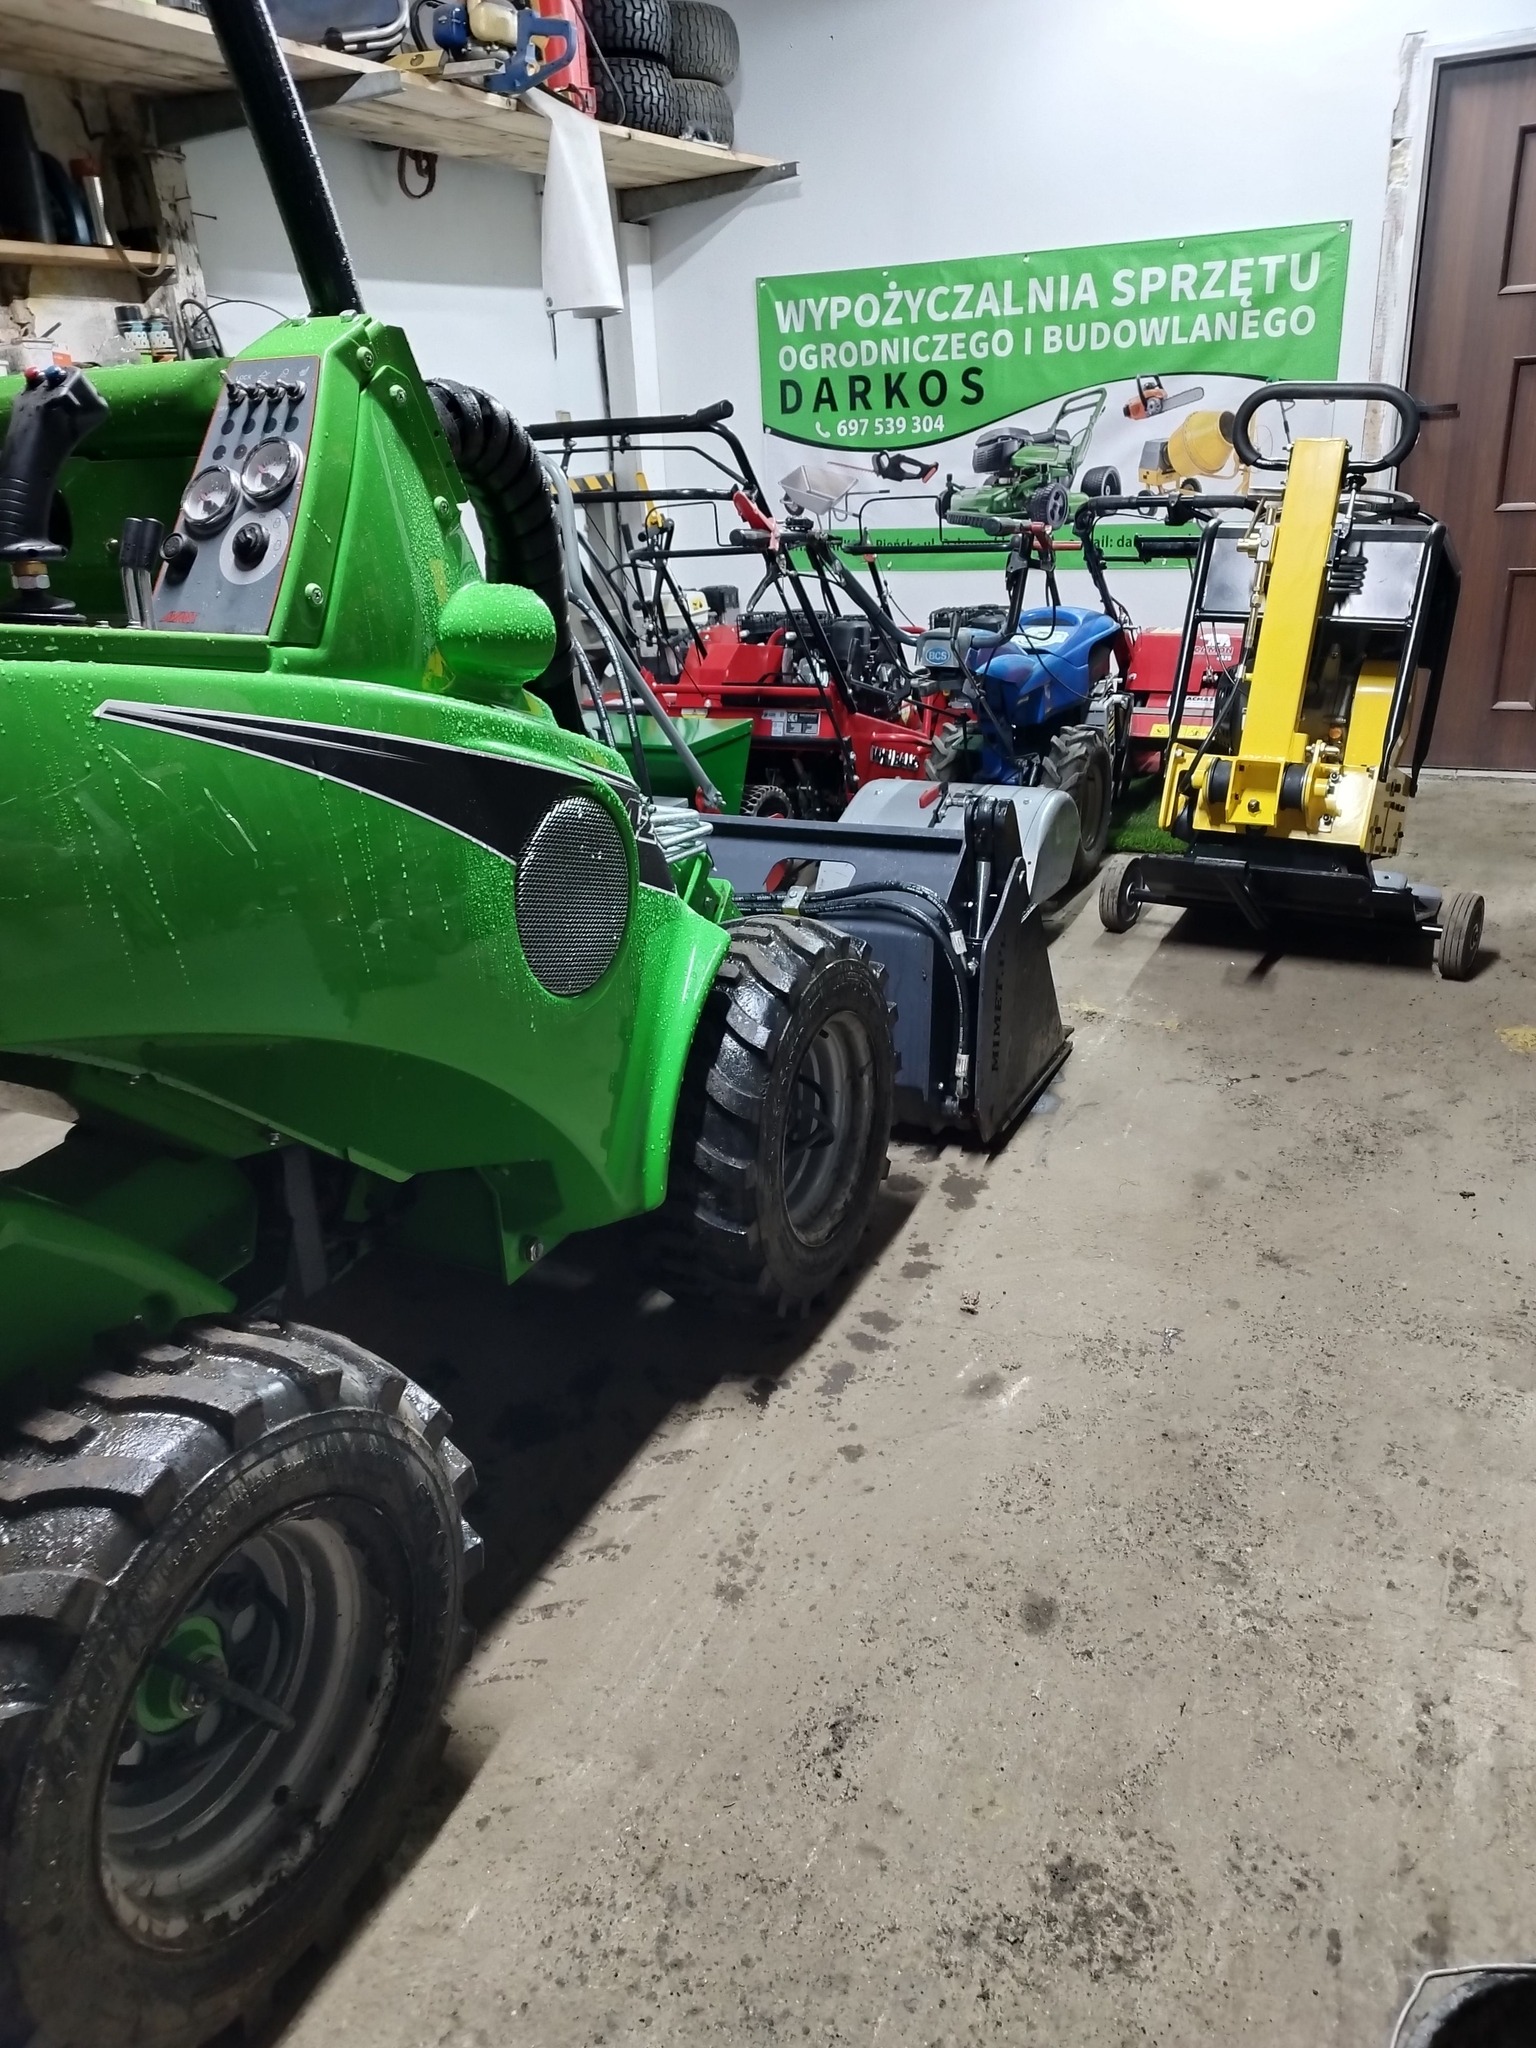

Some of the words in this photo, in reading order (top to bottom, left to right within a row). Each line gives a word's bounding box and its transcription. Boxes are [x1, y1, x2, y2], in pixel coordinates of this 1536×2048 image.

[775, 273, 1099, 333] WYPOŻYCZALNIA
[1111, 251, 1320, 307] SPRZĘTU
[778, 329, 1014, 372] OGRODNICZEGO
[1024, 327, 1032, 355] I
[1043, 305, 1316, 354] BUDOWLANEGO
[780, 367, 984, 414] DARKOS
[836, 418, 869, 437] 697
[874, 416, 907, 435] 539
[911, 415, 945, 433] 304
[928, 651, 948, 662] BCS
